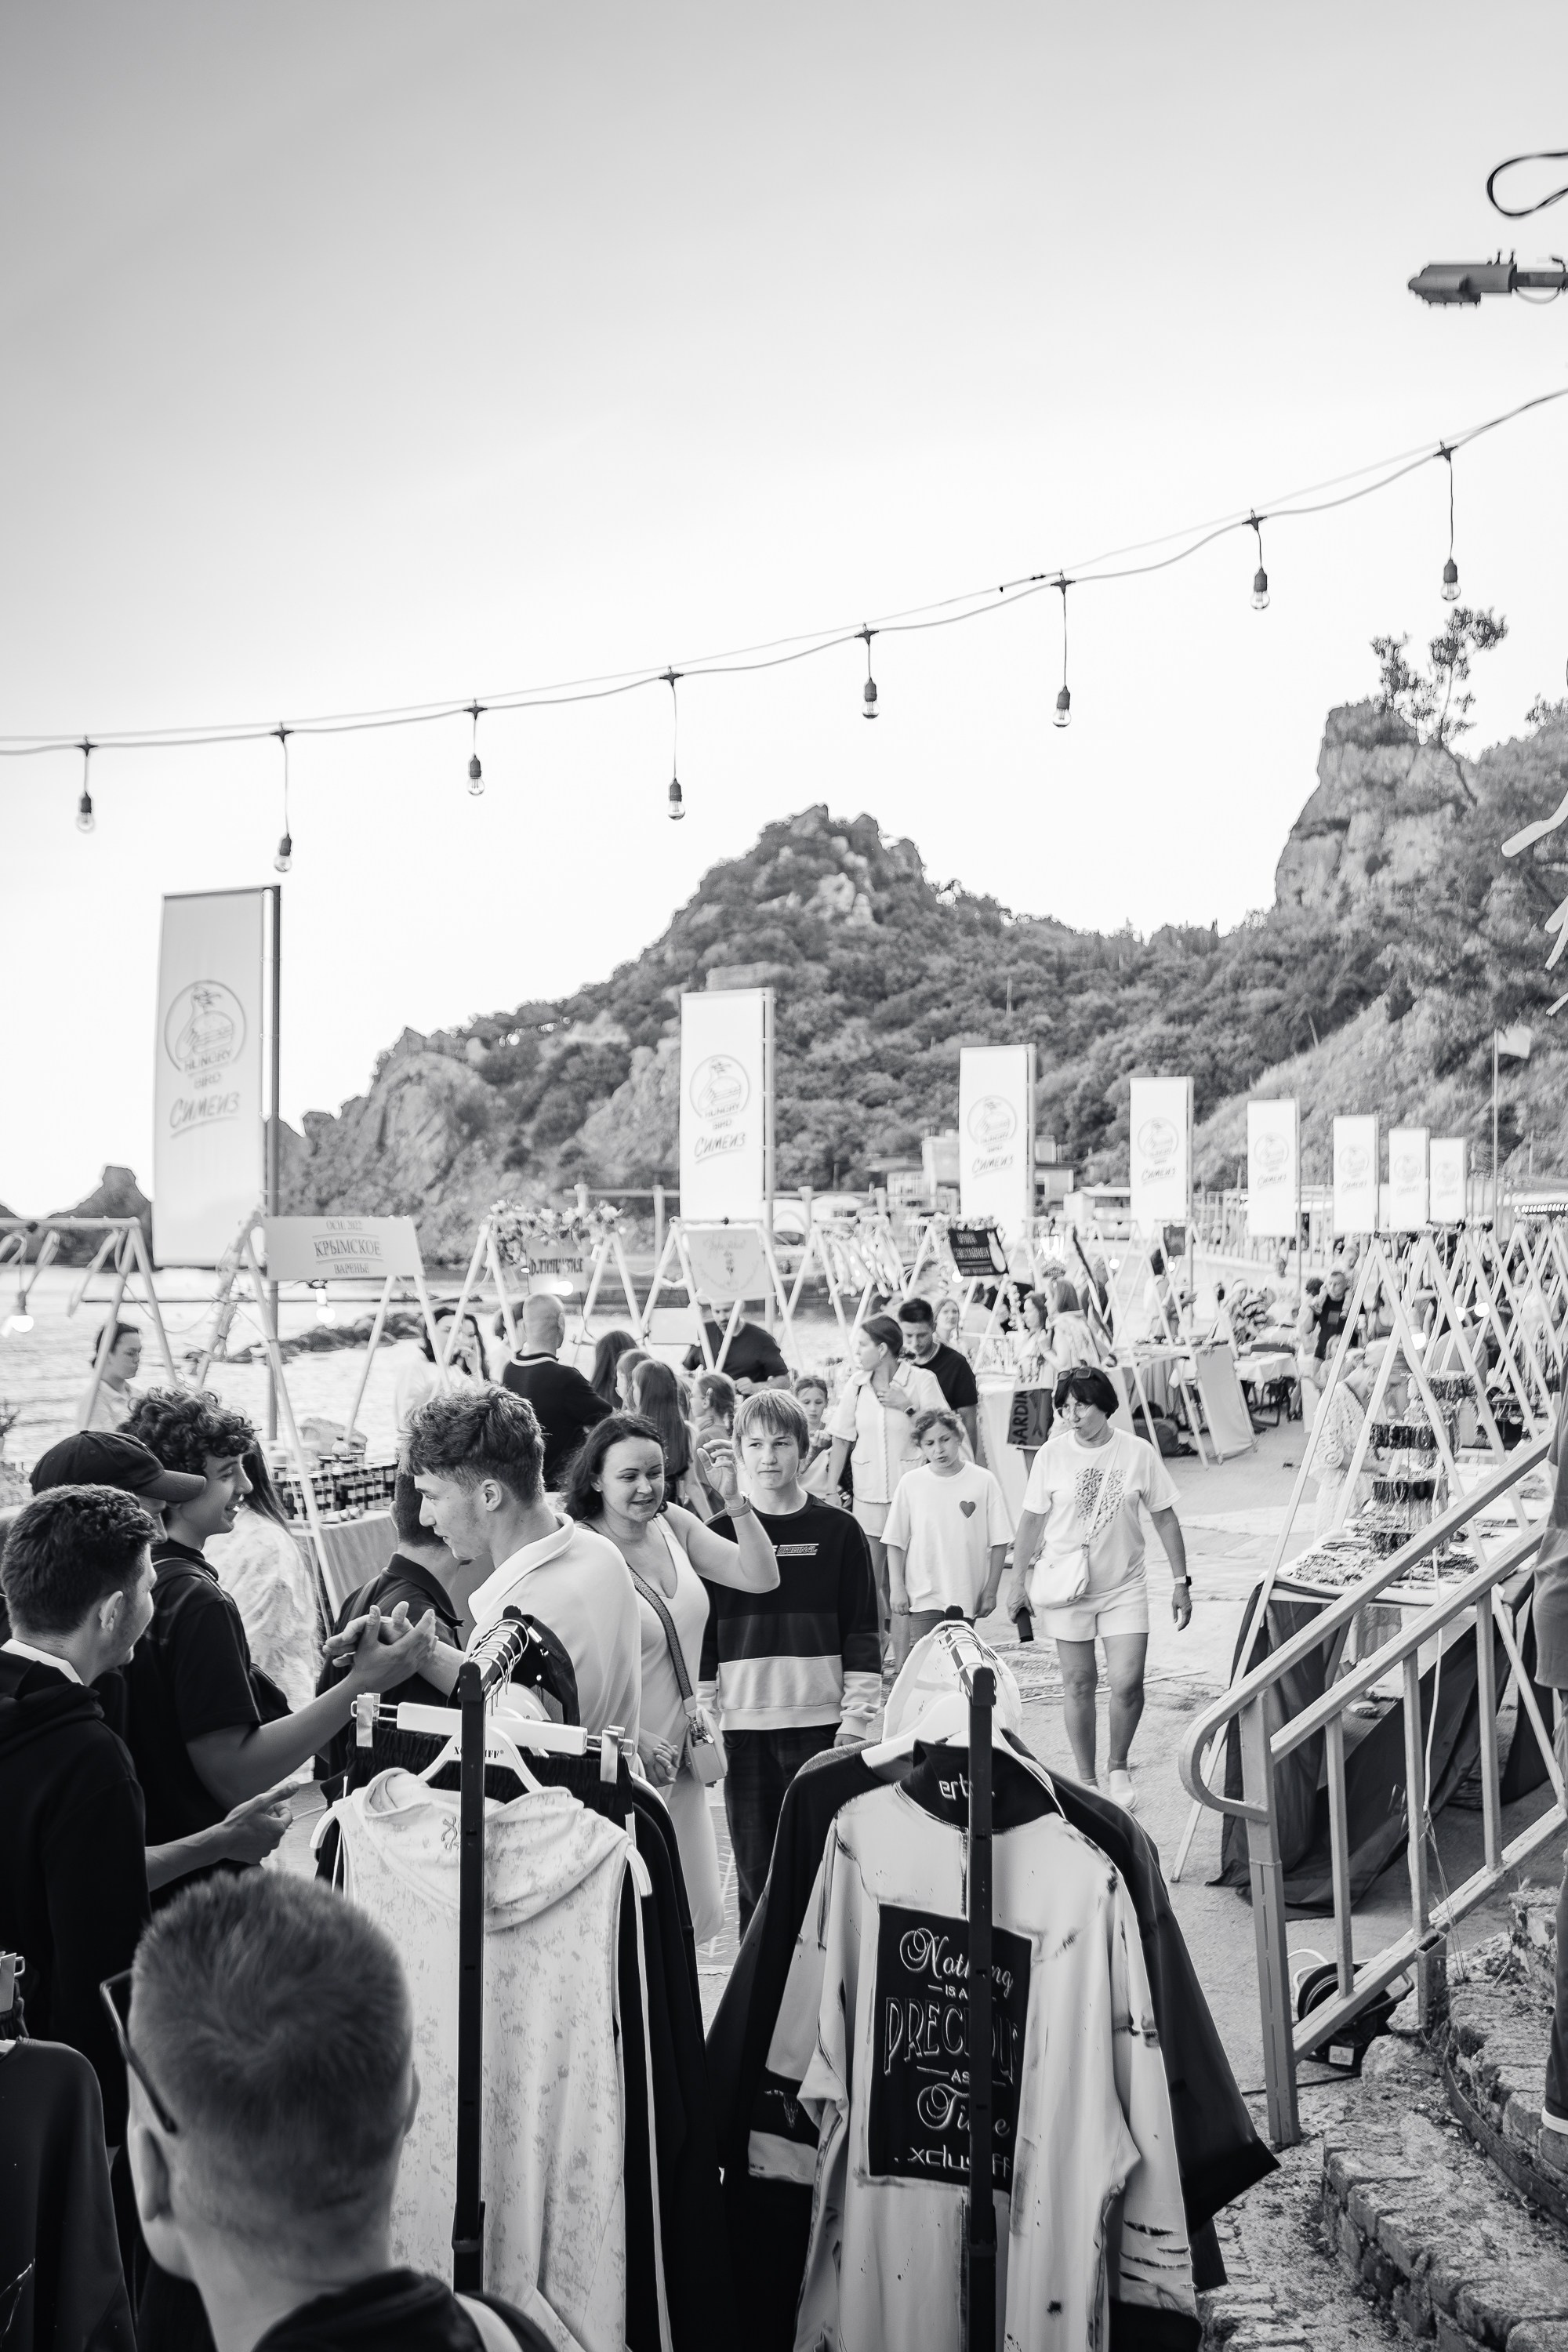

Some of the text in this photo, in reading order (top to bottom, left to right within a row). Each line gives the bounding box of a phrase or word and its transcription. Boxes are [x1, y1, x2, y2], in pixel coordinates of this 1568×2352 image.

[314, 1239, 381, 1257] КРЫМСКОЕ
[899, 1927, 1014, 1998] Notng
[951, 2068, 971, 2085] AS
[917, 2082, 1011, 2137] Tie
